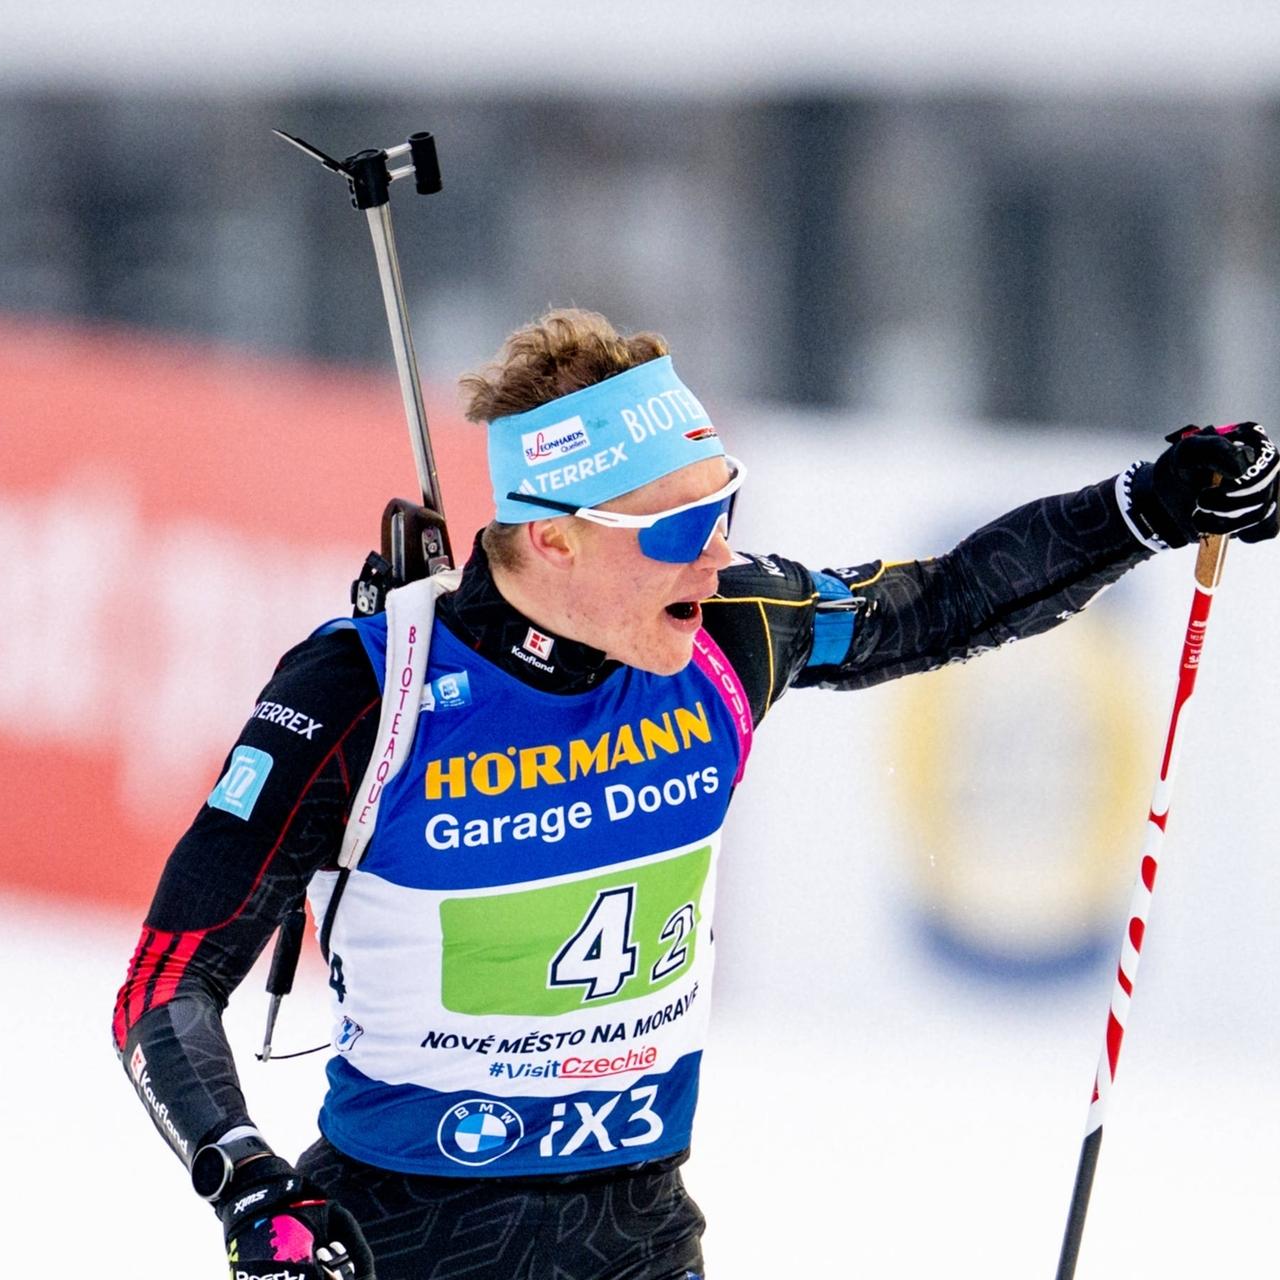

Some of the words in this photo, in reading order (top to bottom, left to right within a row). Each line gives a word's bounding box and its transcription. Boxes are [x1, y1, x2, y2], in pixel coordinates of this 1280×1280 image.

[536, 442, 628, 492] TERREX
[511, 645, 555, 674] Kaufland
[358, 626, 417, 825] BIOTEAQUE
[425, 702, 712, 799] HÖRMANN
[425, 798, 593, 850] Garage
[605, 766, 719, 822] Doors
[548, 886, 637, 1001] 4
[651, 903, 694, 981] 2
[421, 1030, 496, 1055] NOVÉ
[496, 1029, 586, 1054] MĚSTO
[591, 1022, 626, 1044] NA
[140, 1070, 188, 1155] Kaufland
